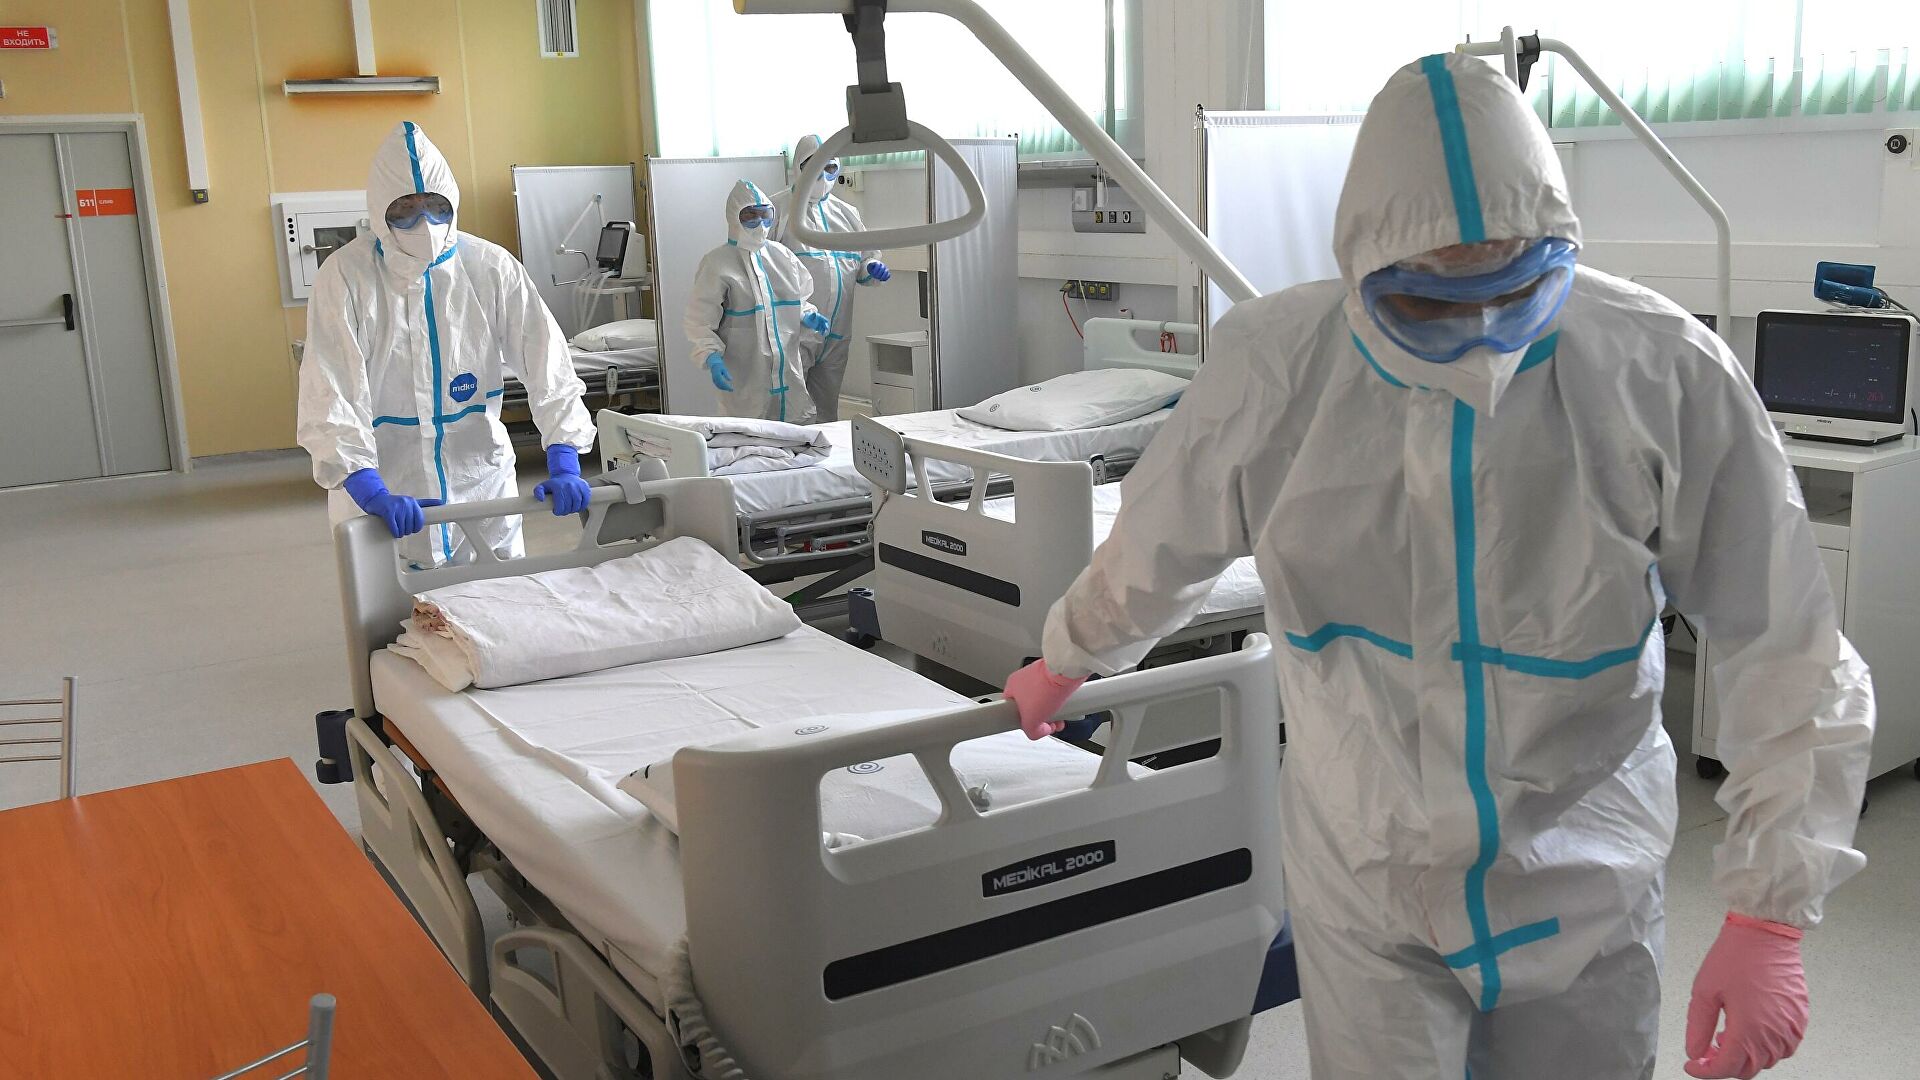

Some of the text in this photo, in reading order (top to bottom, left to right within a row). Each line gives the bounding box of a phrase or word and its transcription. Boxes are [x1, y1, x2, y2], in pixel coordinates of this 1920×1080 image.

[3, 38, 46, 46] ВХОДИТЬ
[949, 542, 964, 553] 2000
[1065, 849, 1104, 871] 2000
